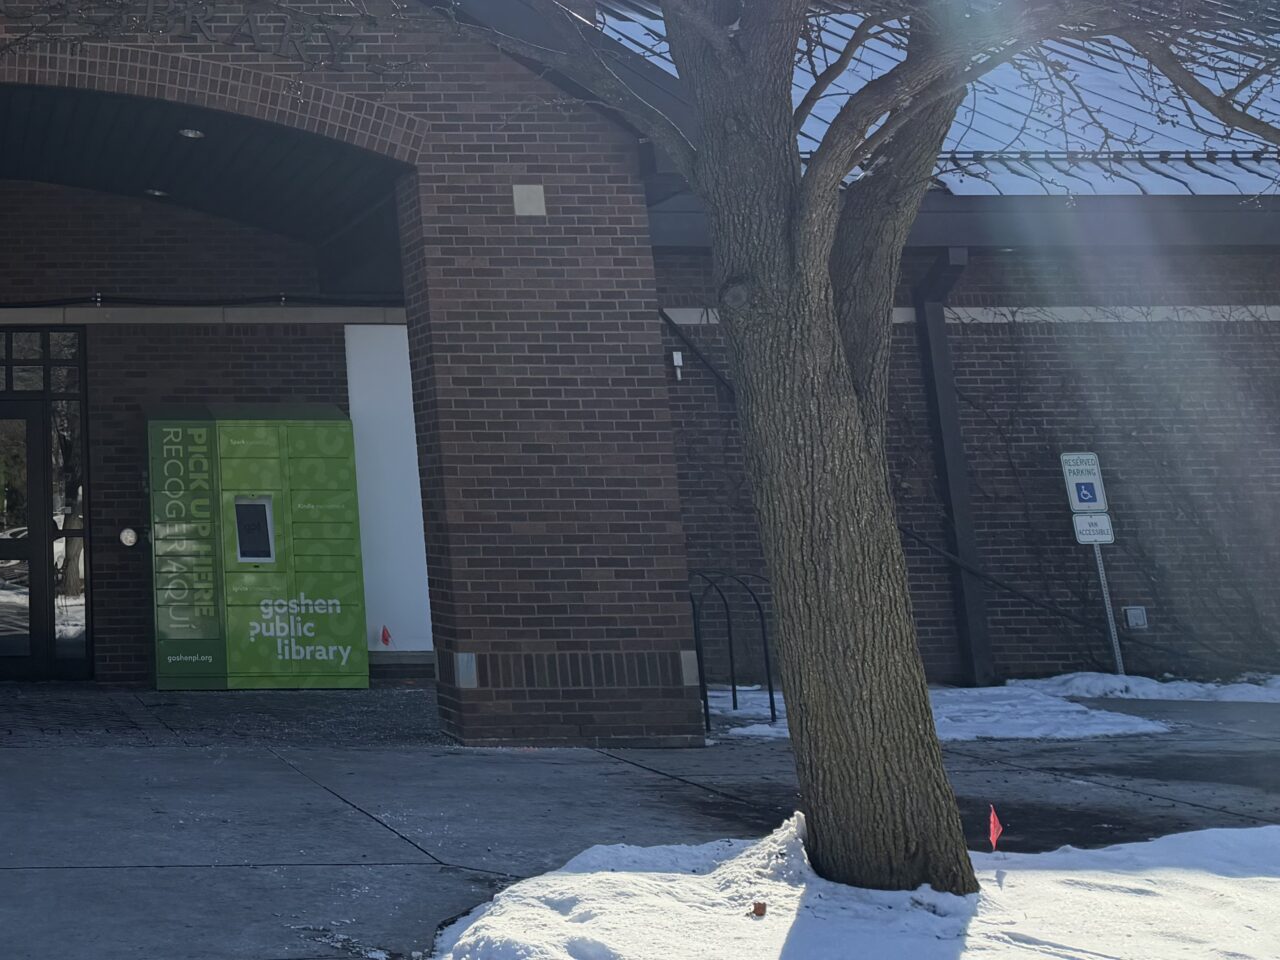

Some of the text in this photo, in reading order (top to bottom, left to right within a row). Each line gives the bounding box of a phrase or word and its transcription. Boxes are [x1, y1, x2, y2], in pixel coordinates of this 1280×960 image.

[1063, 458, 1096, 467] RESERVED
[1067, 468, 1097, 477] PARKING
[187, 427, 215, 617] PICK UP HERE
[161, 427, 197, 630] RECOGER AQUÍ
[1079, 528, 1111, 536] ACCESSIBLE
[259, 592, 341, 619] goshen
[167, 653, 213, 663] goshenpl.org
